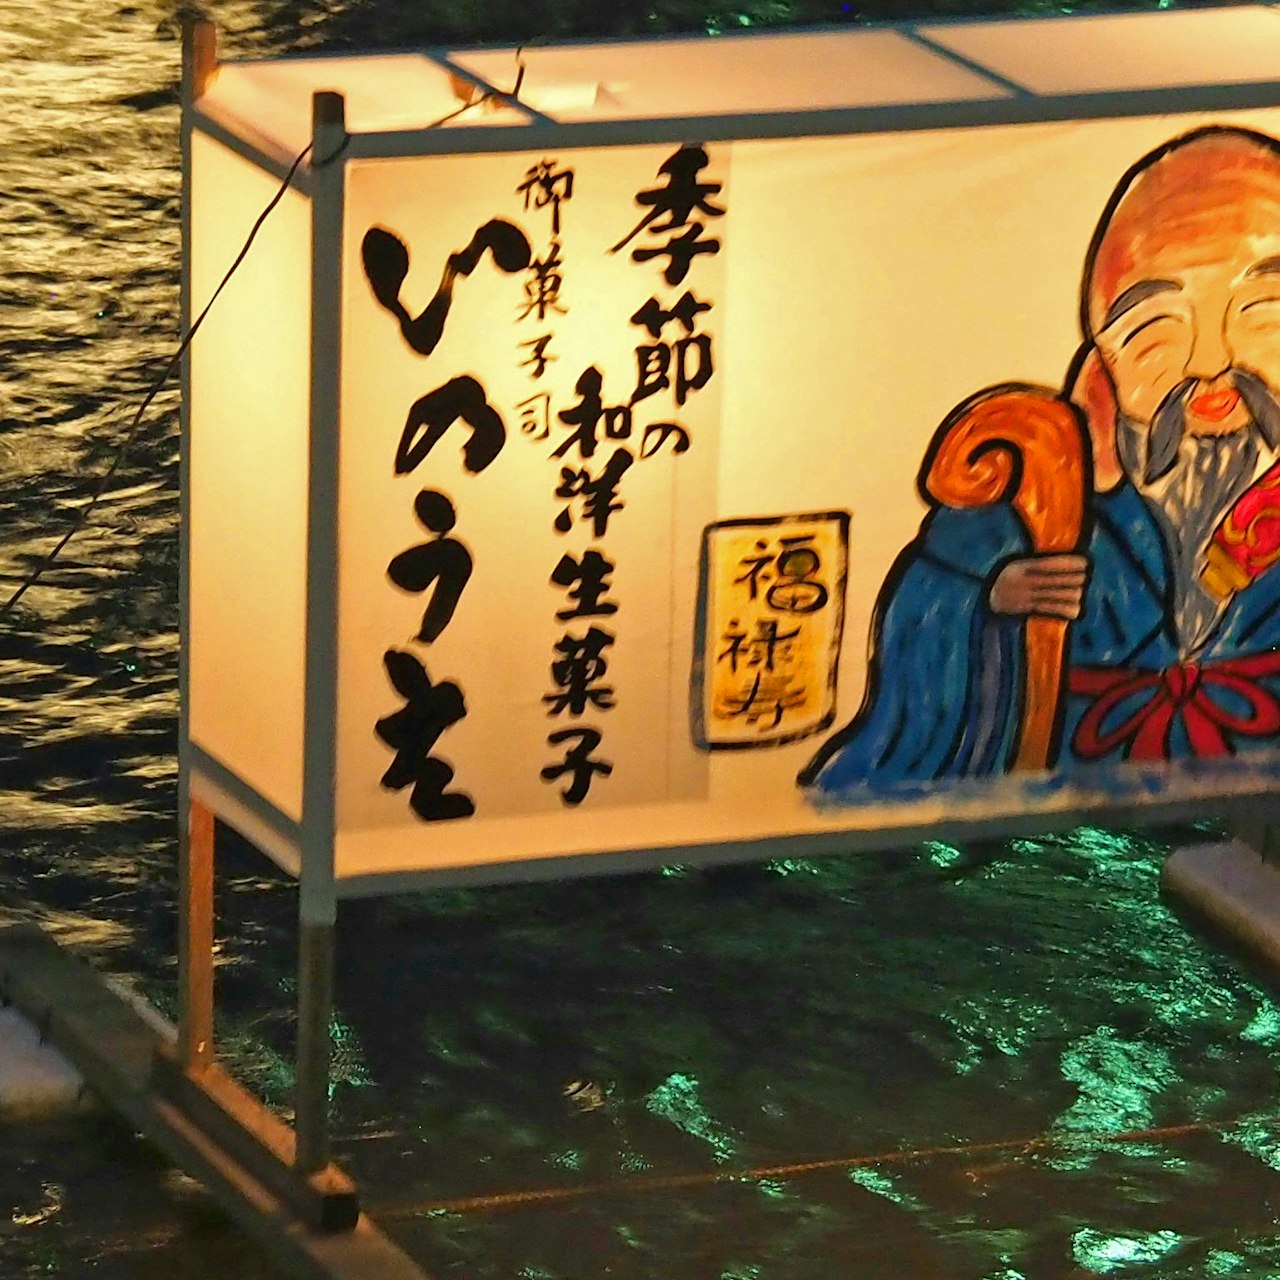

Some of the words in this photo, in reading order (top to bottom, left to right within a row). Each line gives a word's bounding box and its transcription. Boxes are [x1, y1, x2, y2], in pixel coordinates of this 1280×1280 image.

[611, 143, 726, 457] 季節の
[540, 366, 633, 806] 和洋生菓子
